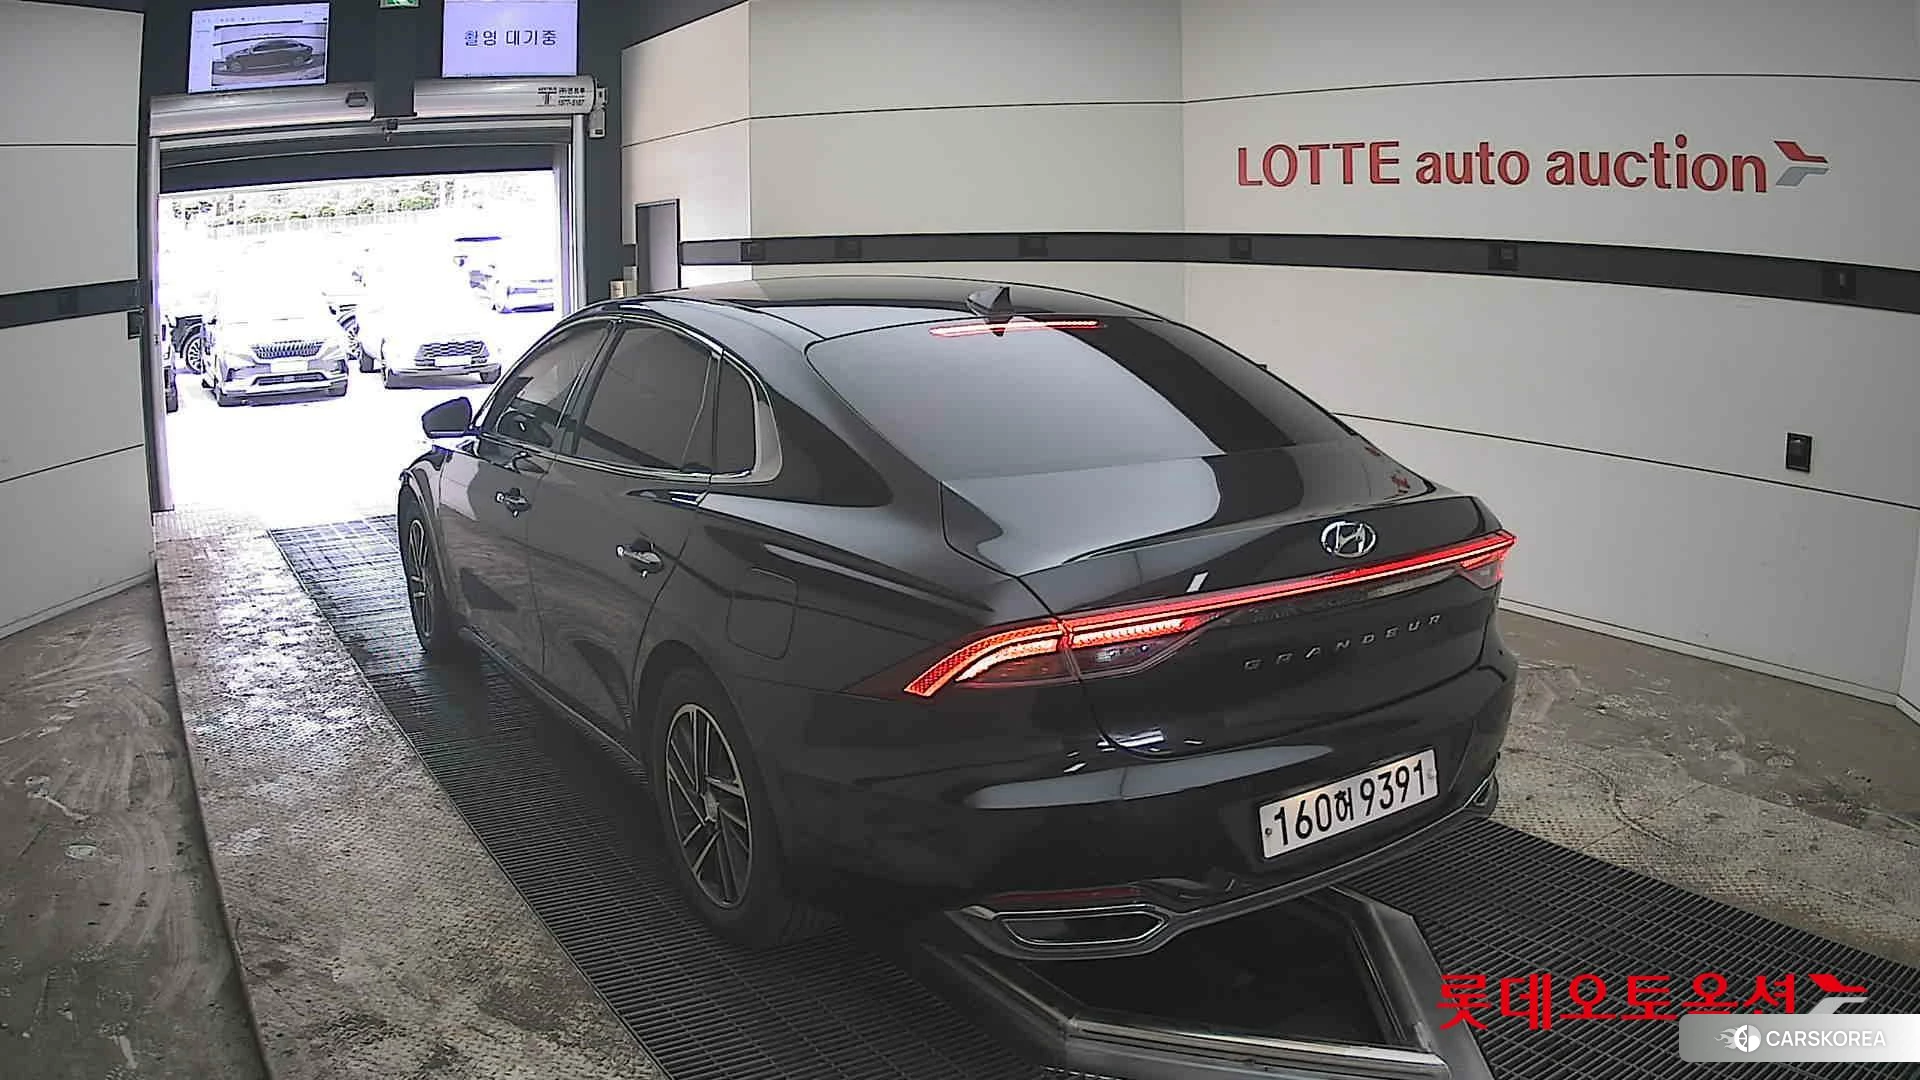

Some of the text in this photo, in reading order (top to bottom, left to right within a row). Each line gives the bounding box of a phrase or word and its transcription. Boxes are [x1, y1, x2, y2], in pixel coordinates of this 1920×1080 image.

[505, 29, 557, 46] 대기중
[1238, 134, 1767, 193] LOTTE auto auction
[1243, 613, 1441, 671] GRANDEUR
